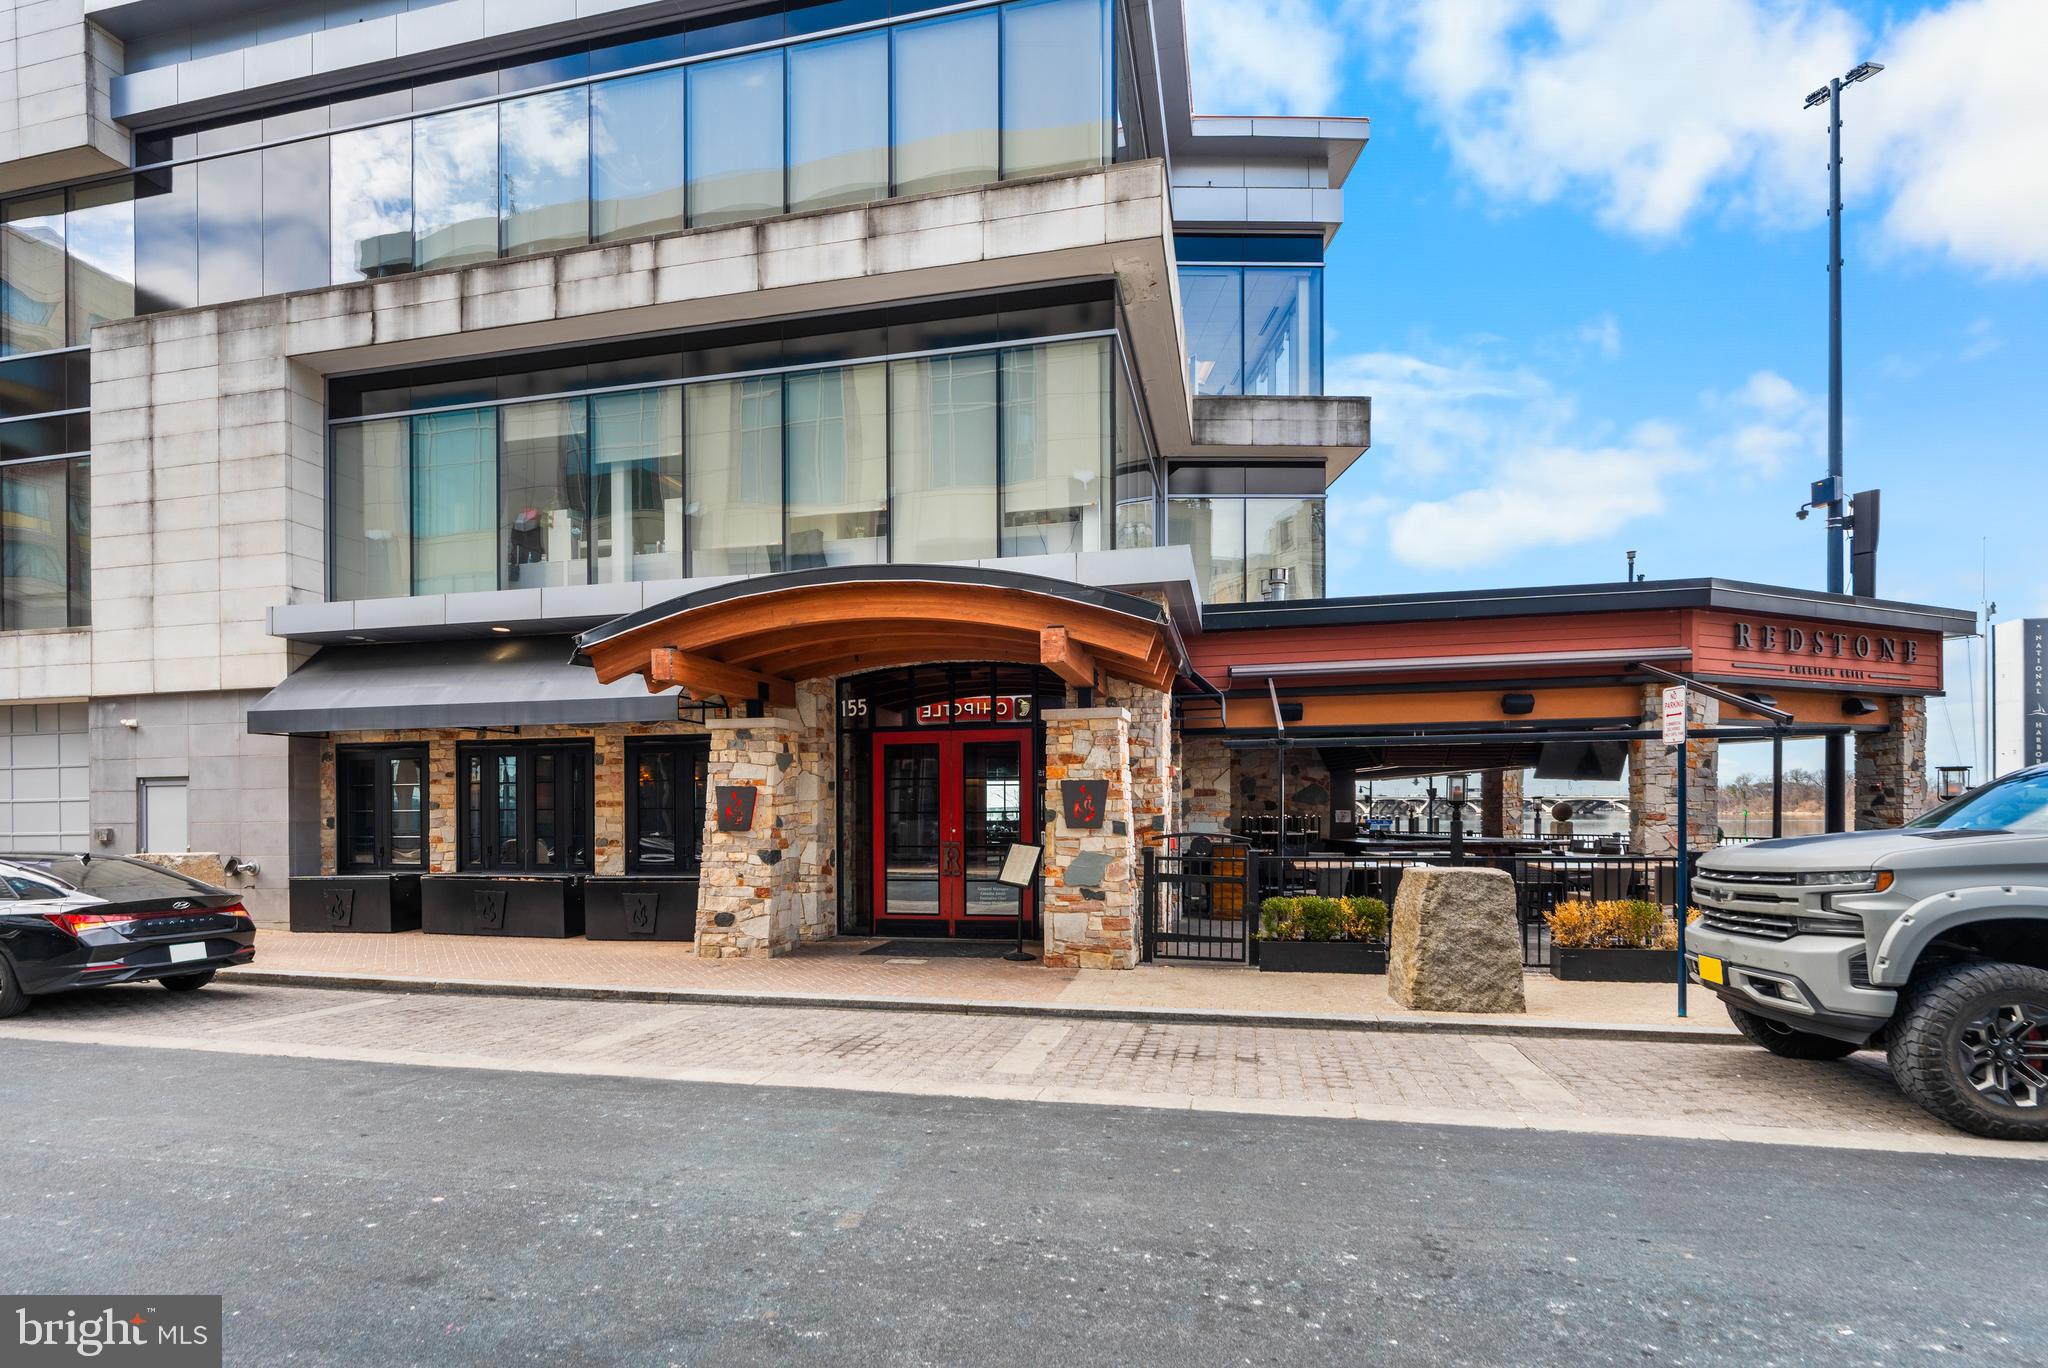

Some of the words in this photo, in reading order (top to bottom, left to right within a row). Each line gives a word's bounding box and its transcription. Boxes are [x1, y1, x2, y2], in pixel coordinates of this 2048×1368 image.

[1737, 623, 1918, 663] REDSTONE
[841, 698, 867, 717] 155
[1664, 700, 1684, 709] PARKING
